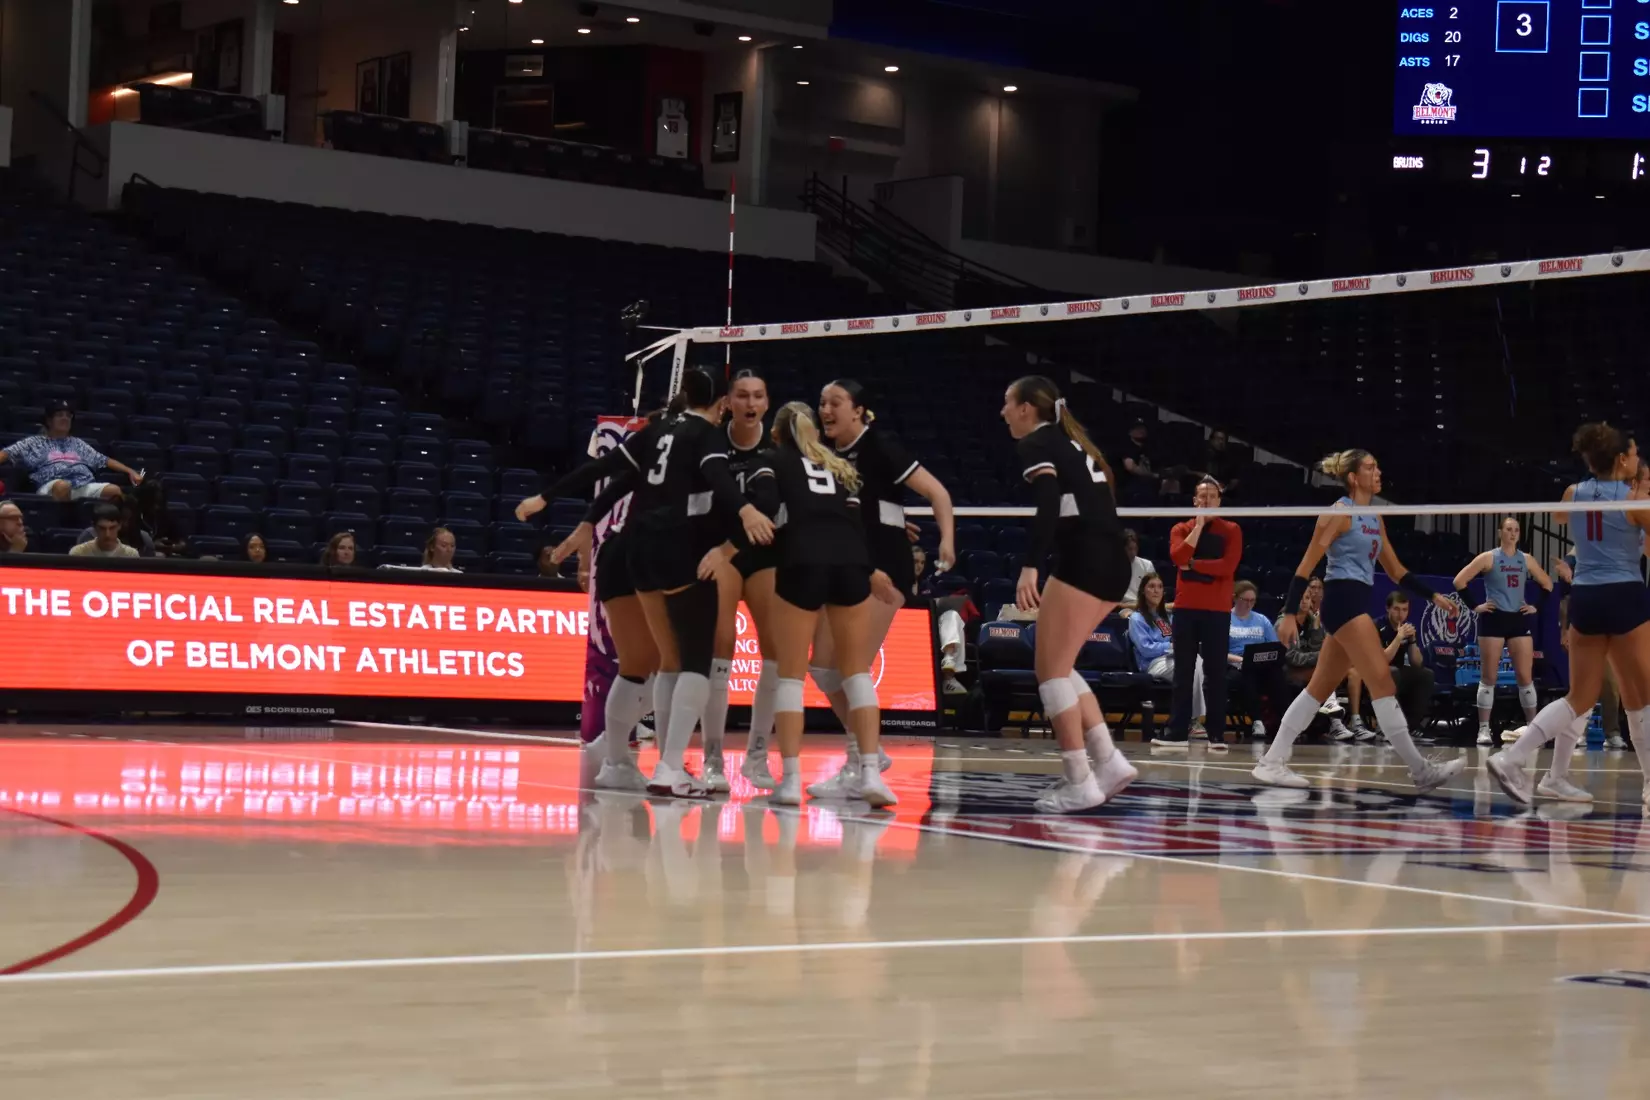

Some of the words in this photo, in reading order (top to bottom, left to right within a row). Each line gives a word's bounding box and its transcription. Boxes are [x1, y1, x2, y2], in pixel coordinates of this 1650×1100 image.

[1400, 8, 1434, 18] ACES
[1449, 7, 1459, 19] 2
[1516, 13, 1533, 37] 3
[1400, 32, 1430, 43] DIGS
[1444, 31, 1462, 43] 20
[1398, 57, 1431, 67] ASTS
[1444, 55, 1461, 67] 17
[1414, 107, 1455, 119] BELMONT
[1393, 156, 1424, 169] BRUINS
[1471, 149, 1490, 179] 3
[916, 313, 945, 325] BRUINS
[991, 307, 1020, 319] BELMONT
[1067, 301, 1101, 313] BRUINS
[1151, 294, 1185, 307] BELMONT
[1238, 287, 1276, 300] BRUINS
[1333, 278, 1370, 292] BELMONT
[1431, 268, 1474, 284] BRUINS
[1539, 257, 1583, 273] BELMONT
[647, 434, 675, 485] 3
[1368, 539, 1379, 560] 3
[1507, 574, 1519, 587] 15
[1, 587, 72, 617] THE
[82, 590, 244, 622] OFFICIAL
[253, 597, 340, 626] REAL
[348, 601, 467, 631] ESTATE
[476, 606, 589, 636] PARTNE
[735, 639, 759, 655] NG
[126, 639, 175, 667] OF
[186, 641, 346, 672] BELMONT
[355, 647, 525, 678] ATHLETICS
[731, 659, 762, 675] RWE
[728, 677, 758, 692] ALTO
[264, 706, 336, 715] SCOREBOARDS
[880, 719, 937, 727] SCOREBOARDS
